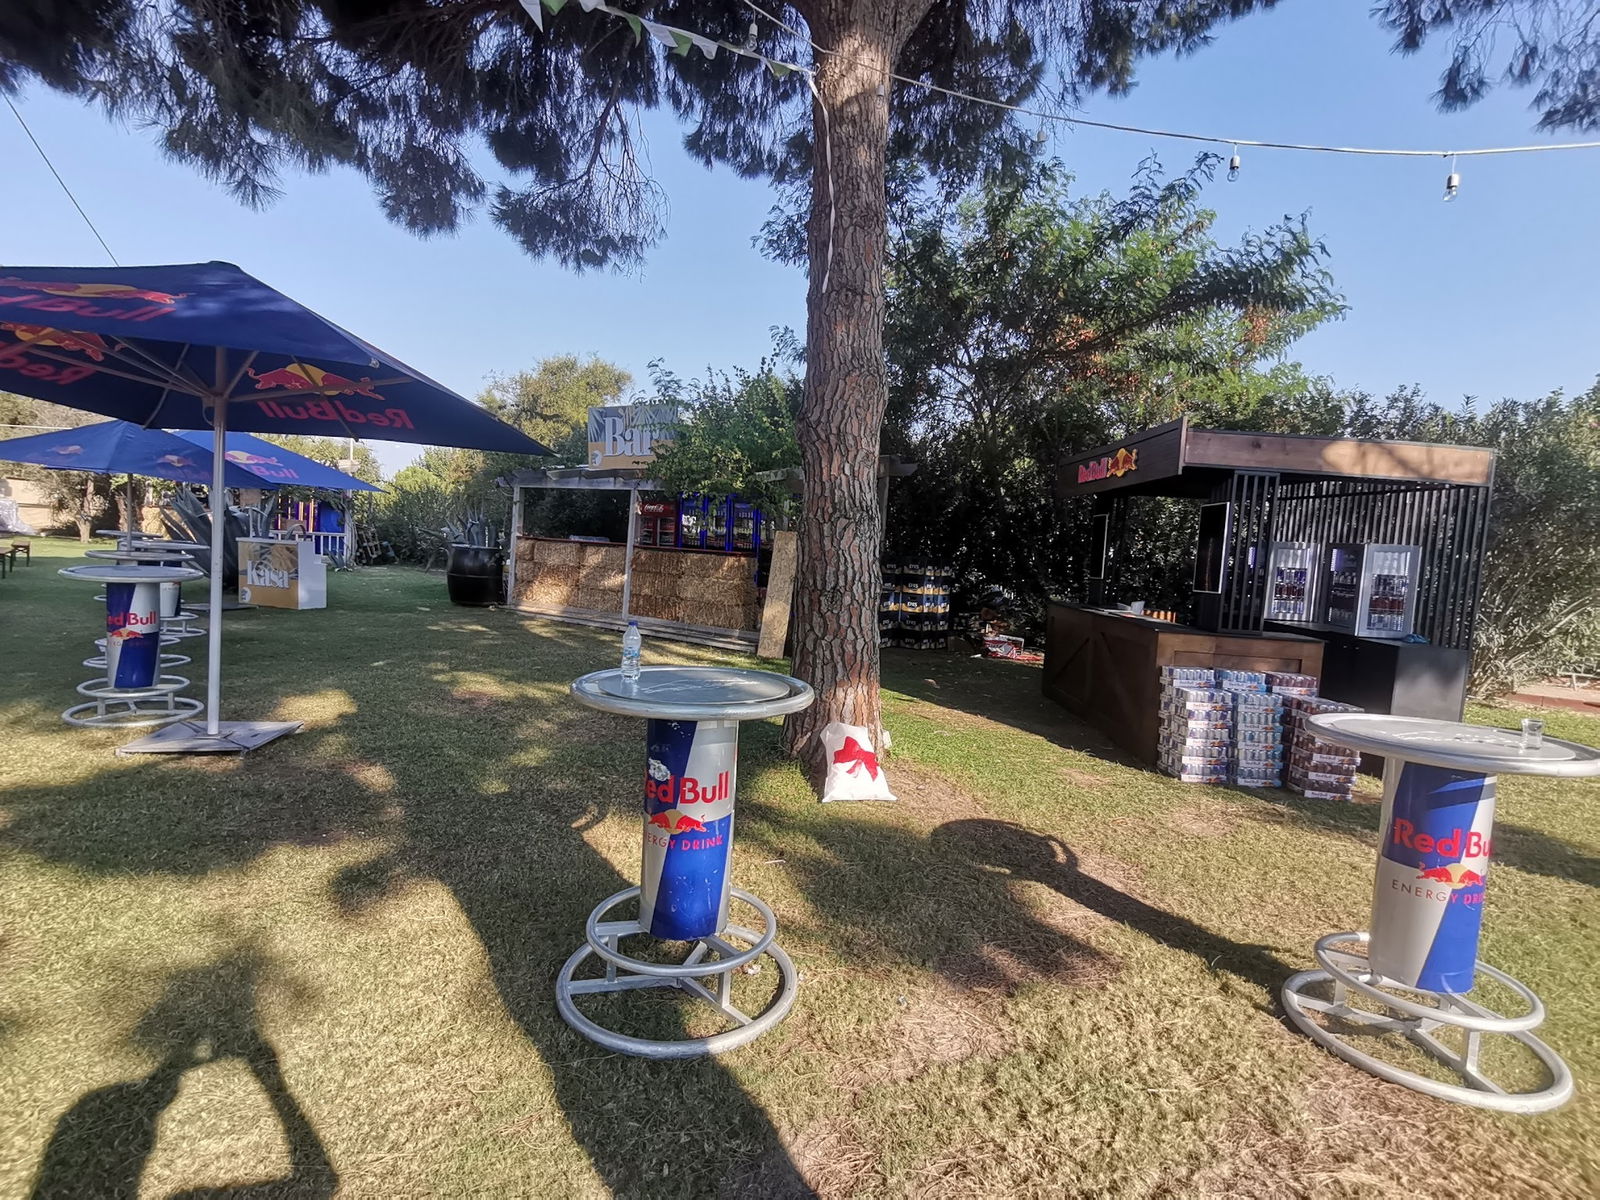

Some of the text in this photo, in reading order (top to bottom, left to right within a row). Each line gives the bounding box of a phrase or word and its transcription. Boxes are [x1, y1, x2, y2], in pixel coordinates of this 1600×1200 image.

[603, 416, 653, 457] Bar
[246, 560, 290, 589] Kasa
[107, 611, 157, 626] ed Bull
[644, 770, 730, 804] ed Bull
[681, 834, 723, 851] DRINK
[1392, 818, 1462, 858] Red
[1391, 878, 1458, 904] ENERGY
